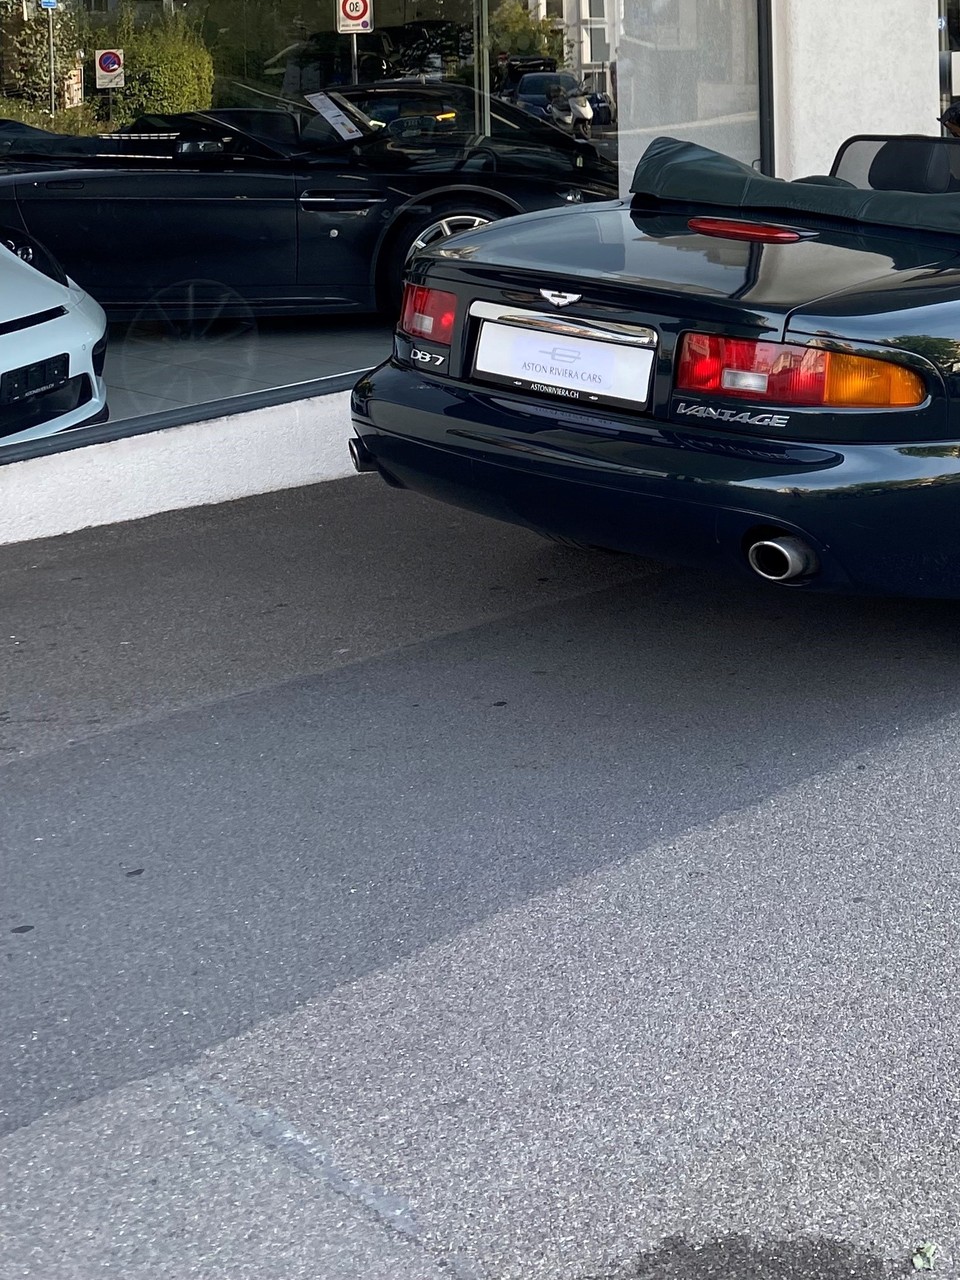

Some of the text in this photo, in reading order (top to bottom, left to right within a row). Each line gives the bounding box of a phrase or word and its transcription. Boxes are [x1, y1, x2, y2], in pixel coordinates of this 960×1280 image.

[411, 349, 445, 365] DB7
[522, 362, 602, 384] ASTON RIVIERA CARS
[530, 383, 580, 399] ASTONRIVIERA.CH
[676, 402, 790, 427] VANTAGE
